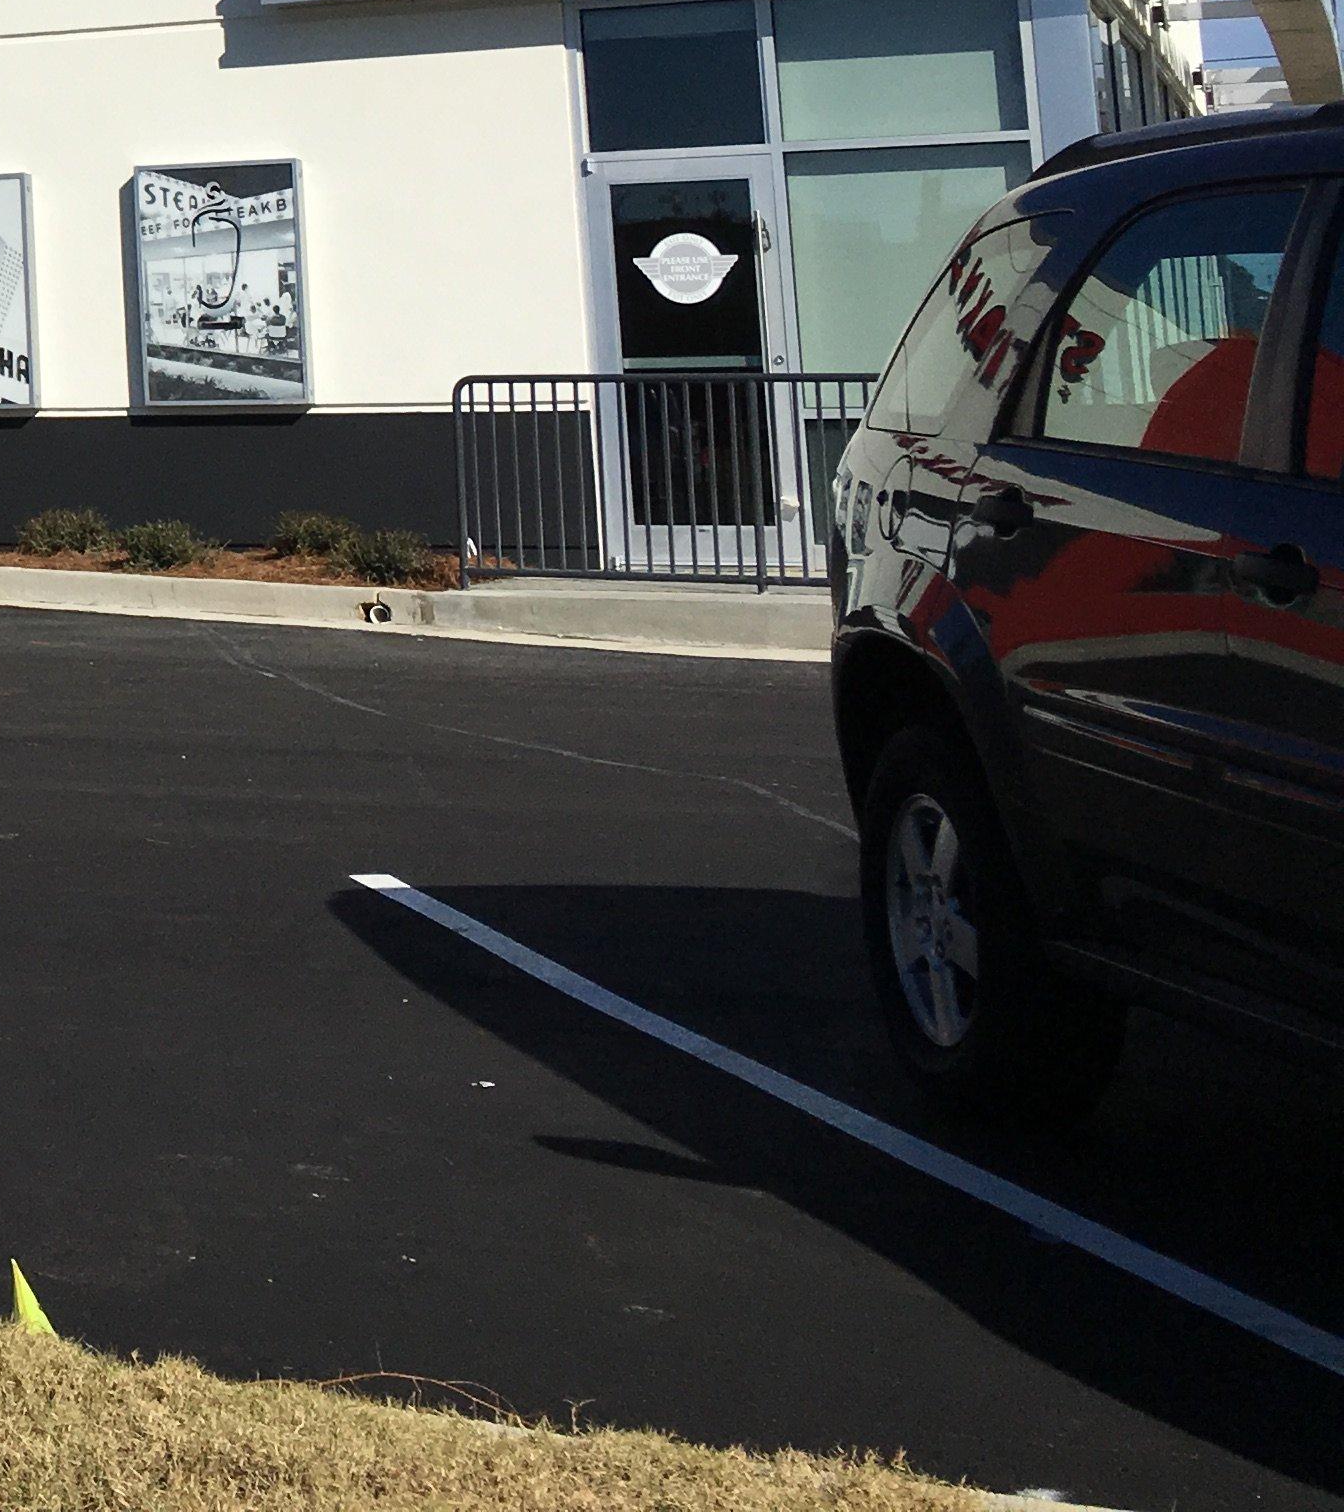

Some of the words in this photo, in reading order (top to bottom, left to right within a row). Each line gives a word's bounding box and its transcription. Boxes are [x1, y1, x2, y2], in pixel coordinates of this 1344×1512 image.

[143, 183, 209, 212] STEA
[670, 265, 701, 273] FRONT
[663, 273, 709, 282] ENTRANCE
